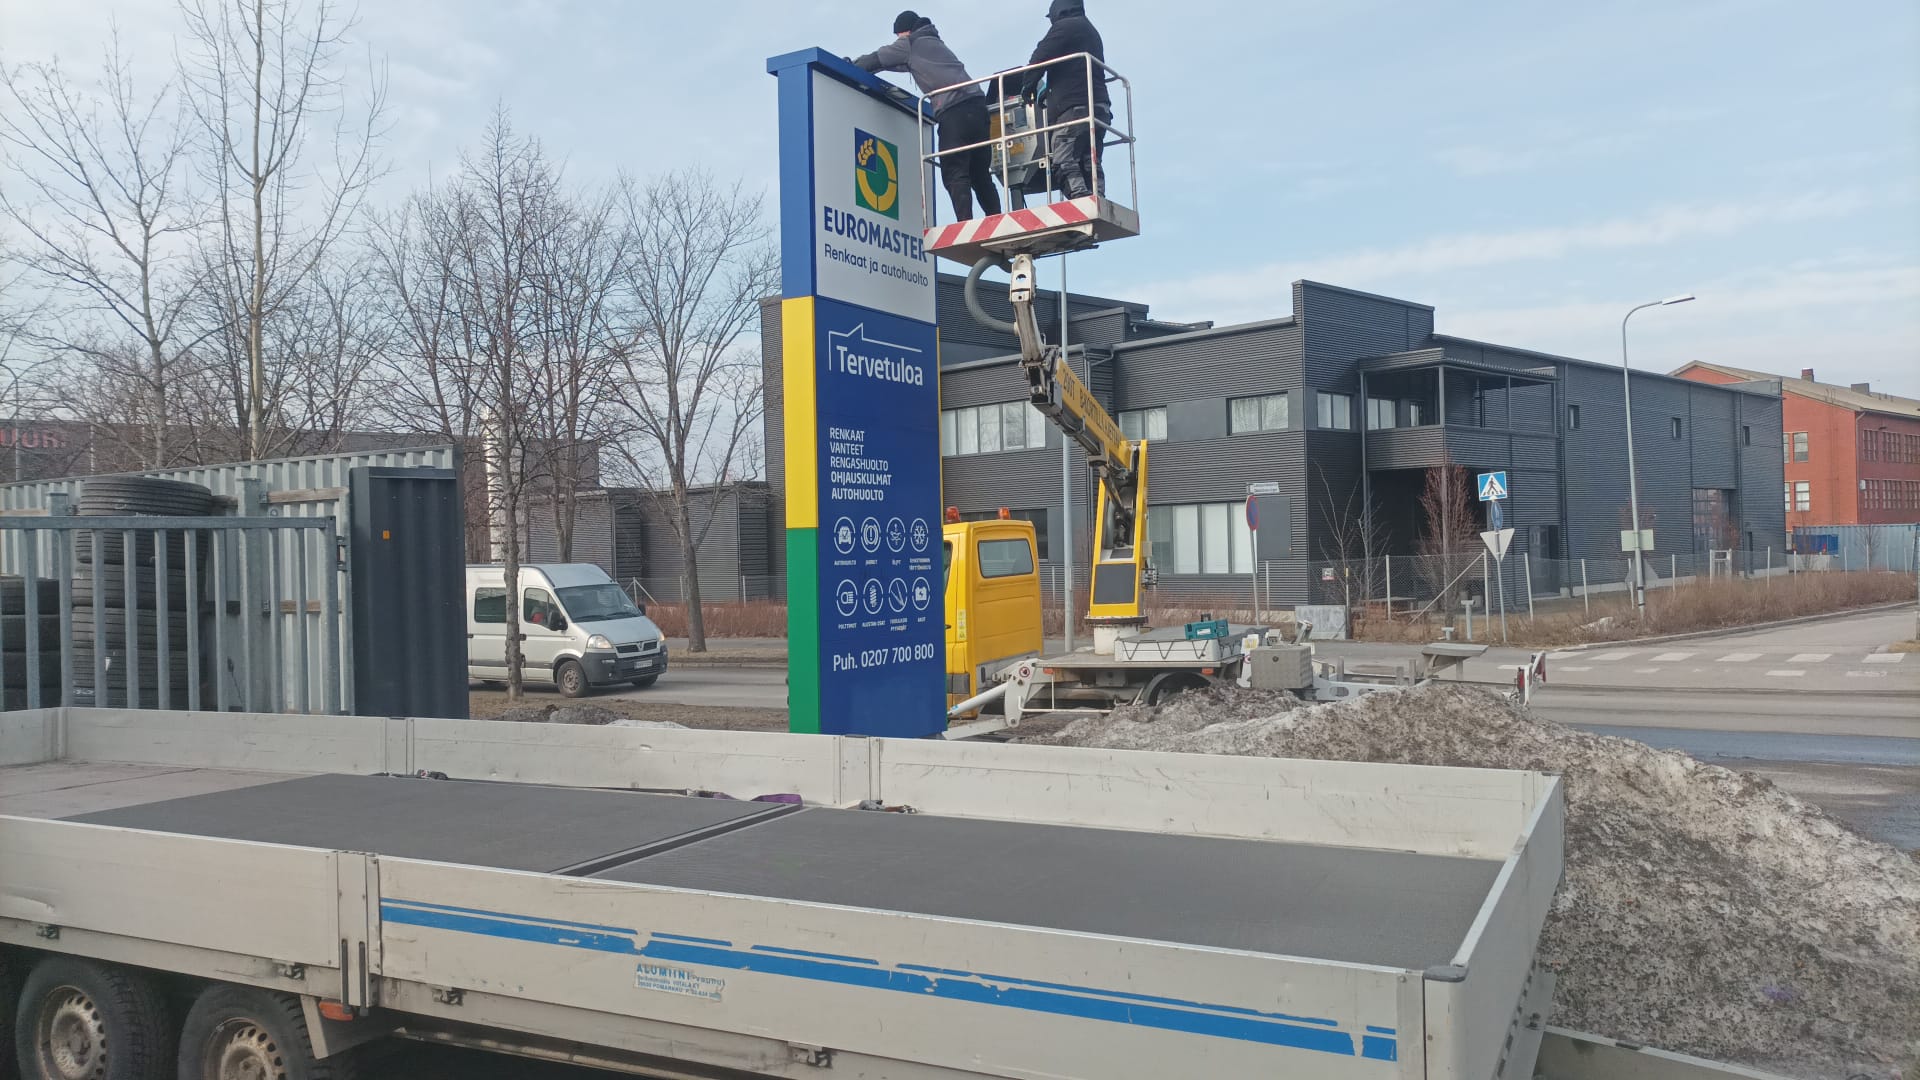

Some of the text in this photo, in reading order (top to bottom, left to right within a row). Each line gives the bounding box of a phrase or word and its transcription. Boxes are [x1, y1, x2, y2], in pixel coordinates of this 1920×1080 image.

[824, 206, 928, 263] EUROMASTER
[825, 243, 929, 287] Renkaat ja autohuolto
[836, 345, 924, 386] Tervetuloa
[829, 427, 865, 442] RENKAAT
[829, 441, 864, 456] VANTEET
[830, 456, 889, 471] RENGASHUOLTO
[830, 471, 892, 486] OHJAUSKULMAT
[831, 488, 884, 501] AUTOHUOLTO
[833, 643, 934, 672] Puh. 0207 700 800
